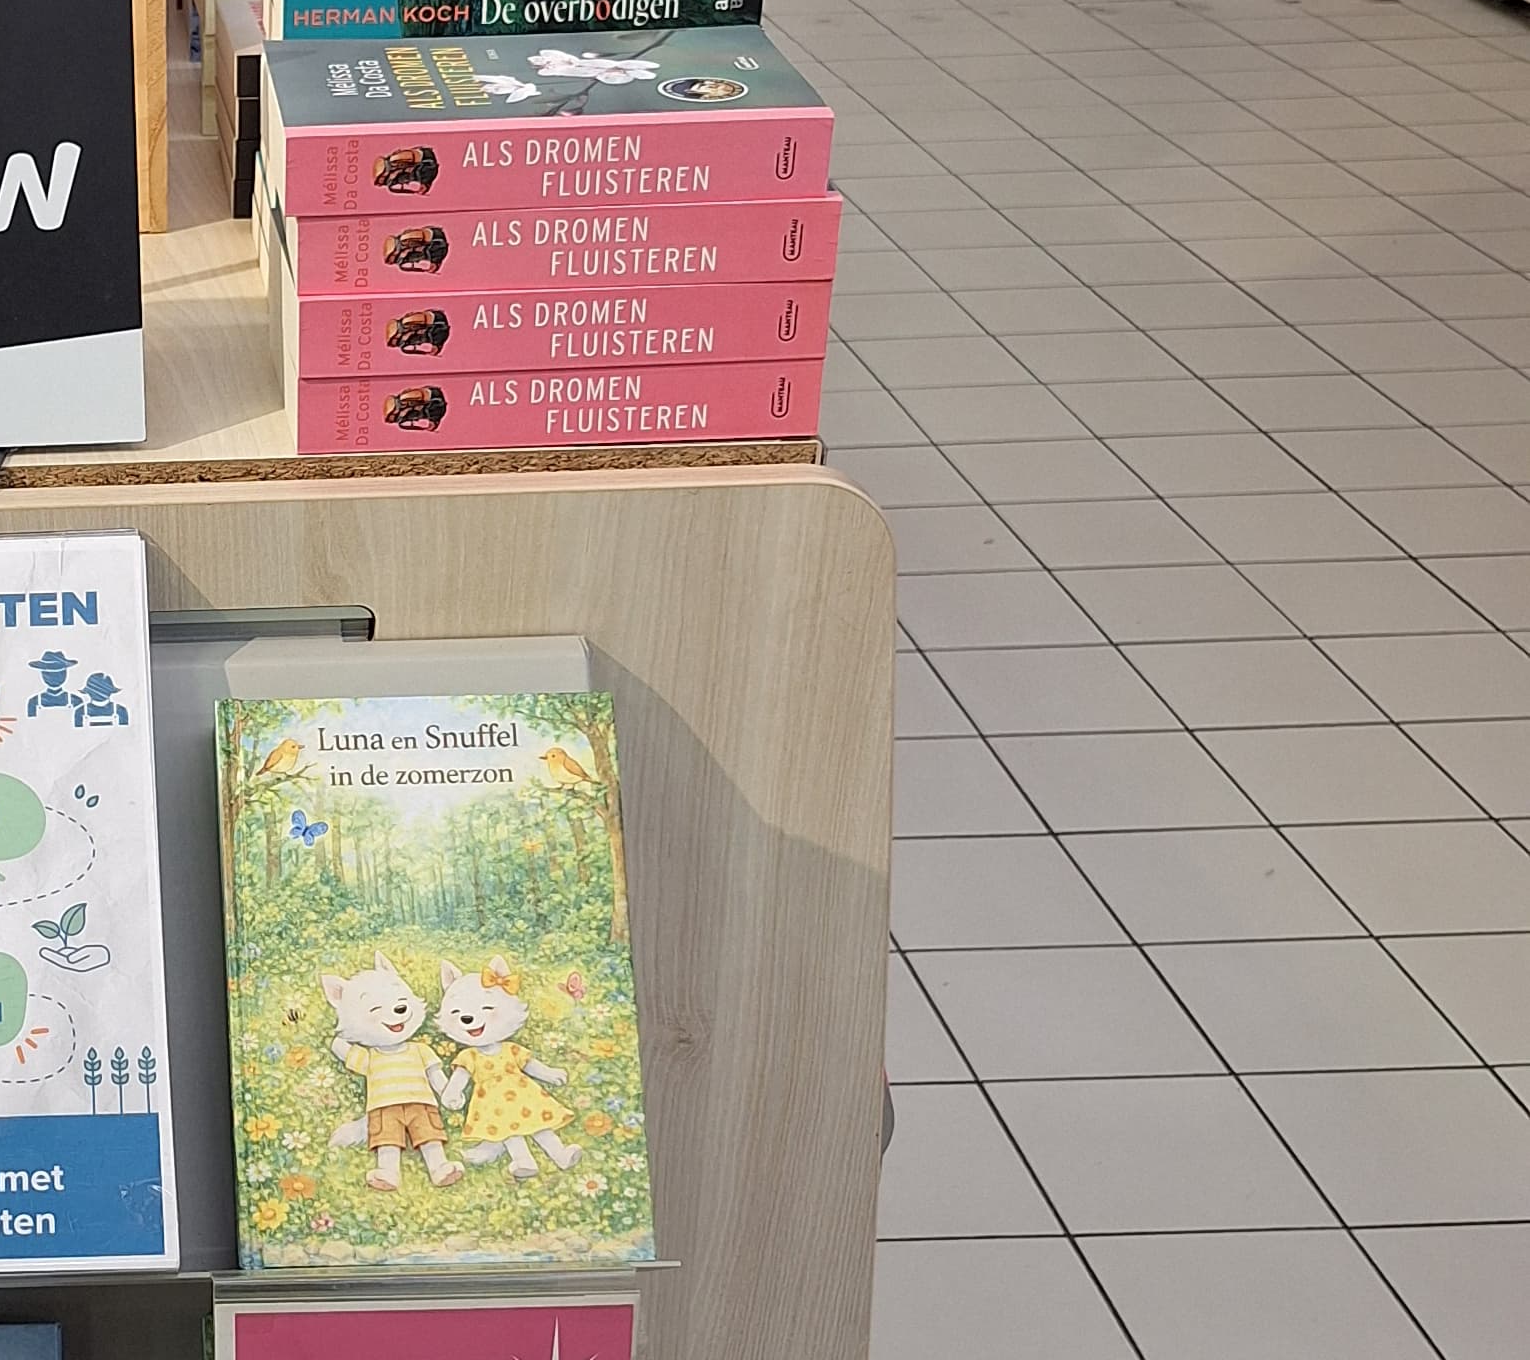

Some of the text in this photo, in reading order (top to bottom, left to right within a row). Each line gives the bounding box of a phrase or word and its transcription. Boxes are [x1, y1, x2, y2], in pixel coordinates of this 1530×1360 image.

[293, 7, 395, 27] HERMAN
[403, 4, 470, 24] KOCH
[327, 63, 359, 98] Mélissa
[355, 59, 393, 99] Da Costa
[384, 46, 446, 110] ALS DROMEN
[429, 47, 493, 108] FLUISTEREN
[463, 135, 641, 168] ALS DROMEN
[782, 136, 792, 174] MANTEAU
[323, 146, 338, 206] Mélissa
[344, 139, 359, 211] Da Costa
[542, 166, 710, 197] FLUISTEREN
[472, 217, 649, 247] ALS DROMEN
[789, 218, 799, 256] MANTEAU
[334, 224, 350, 283] Mélissa
[355, 217, 371, 289] Da Costa
[550, 246, 718, 277] FLUISTEREN
[473, 298, 647, 330] ALS DROMEN
[784, 299, 794, 337] MANTEAU
[337, 308, 353, 367] Mélissa
[357, 302, 373, 371] Da Costa
[550, 327, 715, 359] FLUISTEREN
[470, 375, 642, 406] ALS DROMEN
[776, 377, 786, 412] MANTEAU
[335, 384, 351, 443] Mélissa
[546, 403, 709, 434] FLUISTEREN
[355, 424, 370, 446] Da
[317, 722, 519, 753] Luna en Snuffel
[329, 764, 514, 787] in de zomerzon
